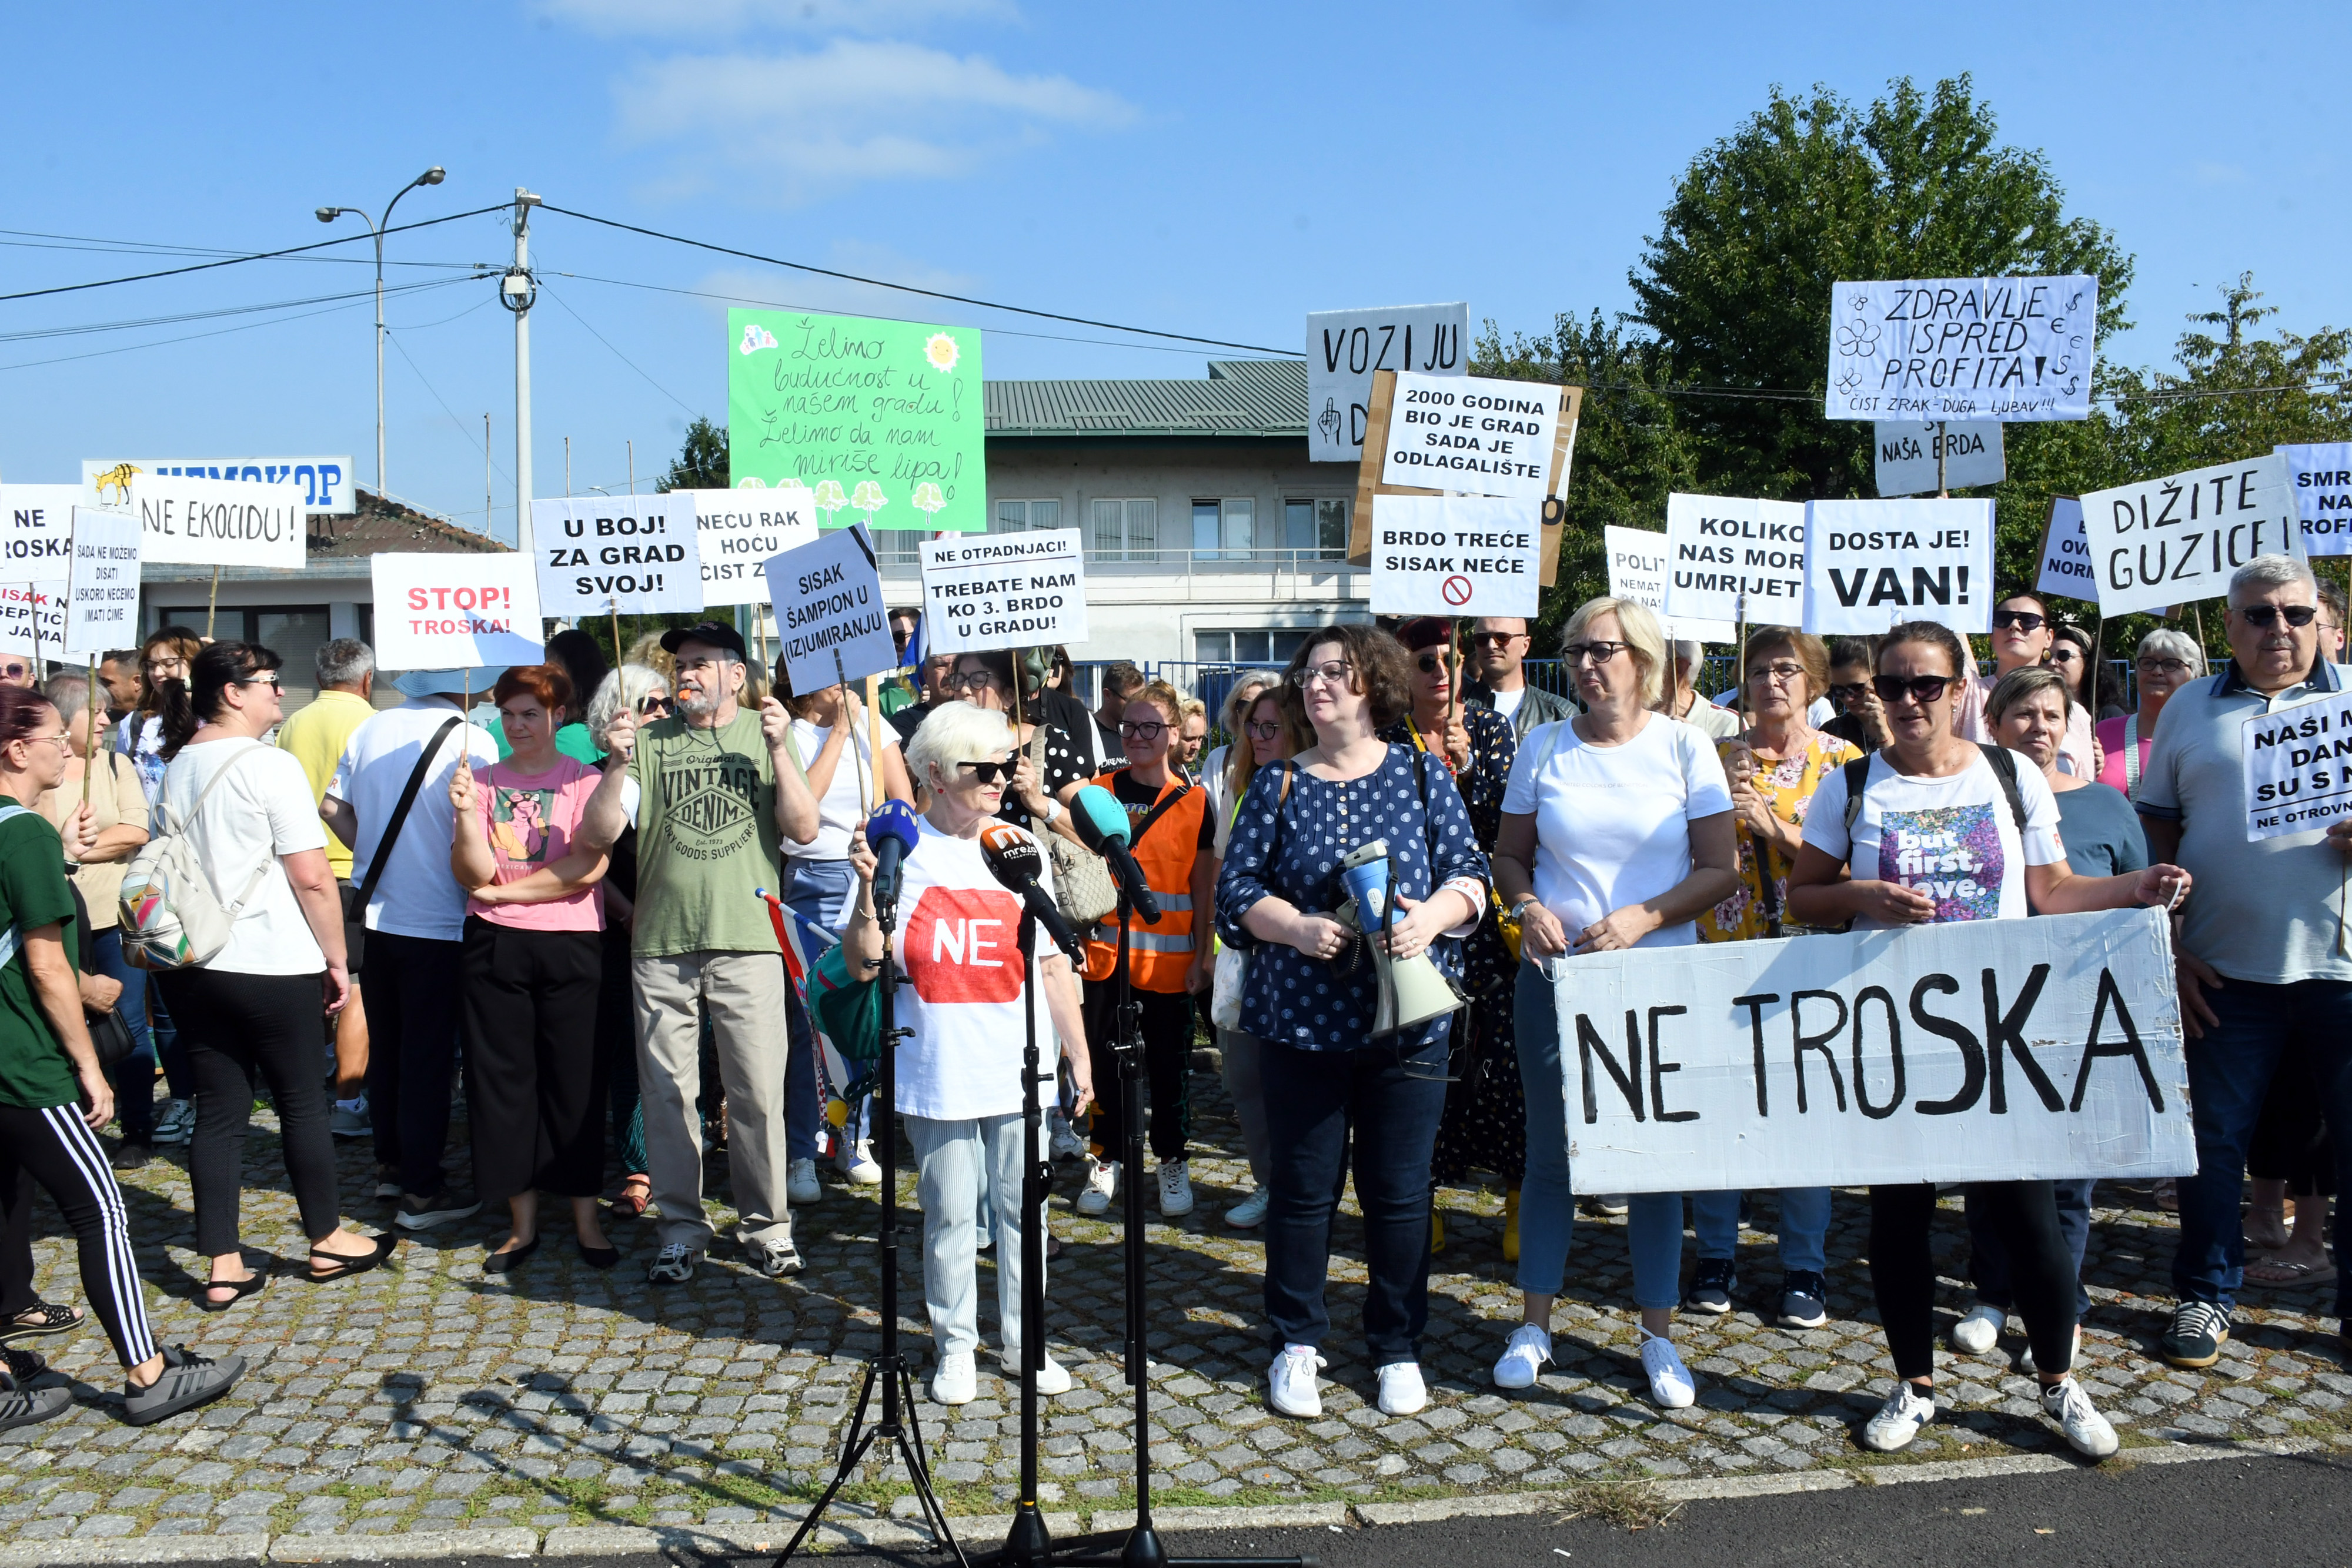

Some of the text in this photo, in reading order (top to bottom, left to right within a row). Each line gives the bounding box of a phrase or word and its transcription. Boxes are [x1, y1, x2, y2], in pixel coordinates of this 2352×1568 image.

[791, 316, 884, 360] Želimo
[1909, 322, 2027, 354] ISPRED
[774, 358, 931, 392] budućnost u
[783, 392, 858, 414] našem
[1406, 389, 1455, 406] 2000
[1462, 394, 1545, 415] GODINA
[1850, 396, 1879, 412] ČIST
[760, 410, 941, 447] Želimo da nam
[1405, 410, 1541, 436] BIO JE GRAD
[1425, 433, 1514, 454] SADA JE
[1883, 437, 1922, 463] NAŠA
[794, 450, 881, 477] miriše
[1394, 450, 1541, 479] ODLAGALIŠTE
[2297, 471, 2352, 487] SMR
[2114, 470, 2259, 534] DIŽITE
[14, 509, 46, 527] NE
[142, 497, 175, 535] NE
[564, 516, 666, 538] U BOJ!
[698, 510, 800, 530] NEĆU RAK
[1383, 530, 1529, 548] BRDO TREĆE
[1700, 517, 1804, 543] KOLIKO
[1829, 529, 1969, 551] DOSTA JE!
[78, 544, 137, 560] SADA NE MOŽEMO
[550, 544, 685, 567] ZA GRAD
[721, 536, 778, 554] HOĆU
[935, 540, 1067, 563] NE OTPADNJACI!
[1679, 543, 1735, 564] NAS
[96, 567, 118, 580] DISATI
[701, 560, 750, 581] ČIST
[1385, 556, 1524, 574] SISAK NEĆE
[576, 574, 663, 595] SVOJ!
[799, 563, 845, 596] SISAK
[931, 573, 1076, 599] TREBATE NAM
[1674, 571, 1802, 599] UMRIJET
[1829, 565, 1969, 607] VAN!
[75, 585, 135, 601] USKORO NEĆEMO
[407, 587, 510, 611] STOP!
[0, 605, 62, 625] EPTIČ
[85, 606, 123, 622] IMATI ČIME
[786, 585, 868, 629] ŠAMPION U
[947, 596, 1064, 618] KO 3. BRDO
[409, 619, 510, 635] TROSKA!
[784, 611, 882, 664] (IZ)UMIRANJU
[958, 616, 1057, 637] U GRADU!
[2254, 716, 2328, 750] NAŠI
[686, 754, 736, 767] Original
[661, 767, 760, 811] VINTAGE
[2257, 777, 2299, 802] SU
[2311, 771, 2330, 790] S
[681, 793, 739, 831] DENIM
[2257, 815, 2279, 828] NE
[664, 823, 756, 861] DRY GOODS SUPPLIERS
[1897, 830, 1958, 850] but
[1896, 850, 1984, 875] first,
[933, 918, 1003, 967] NE
[1575, 963, 2165, 1125] NE TROSKA
